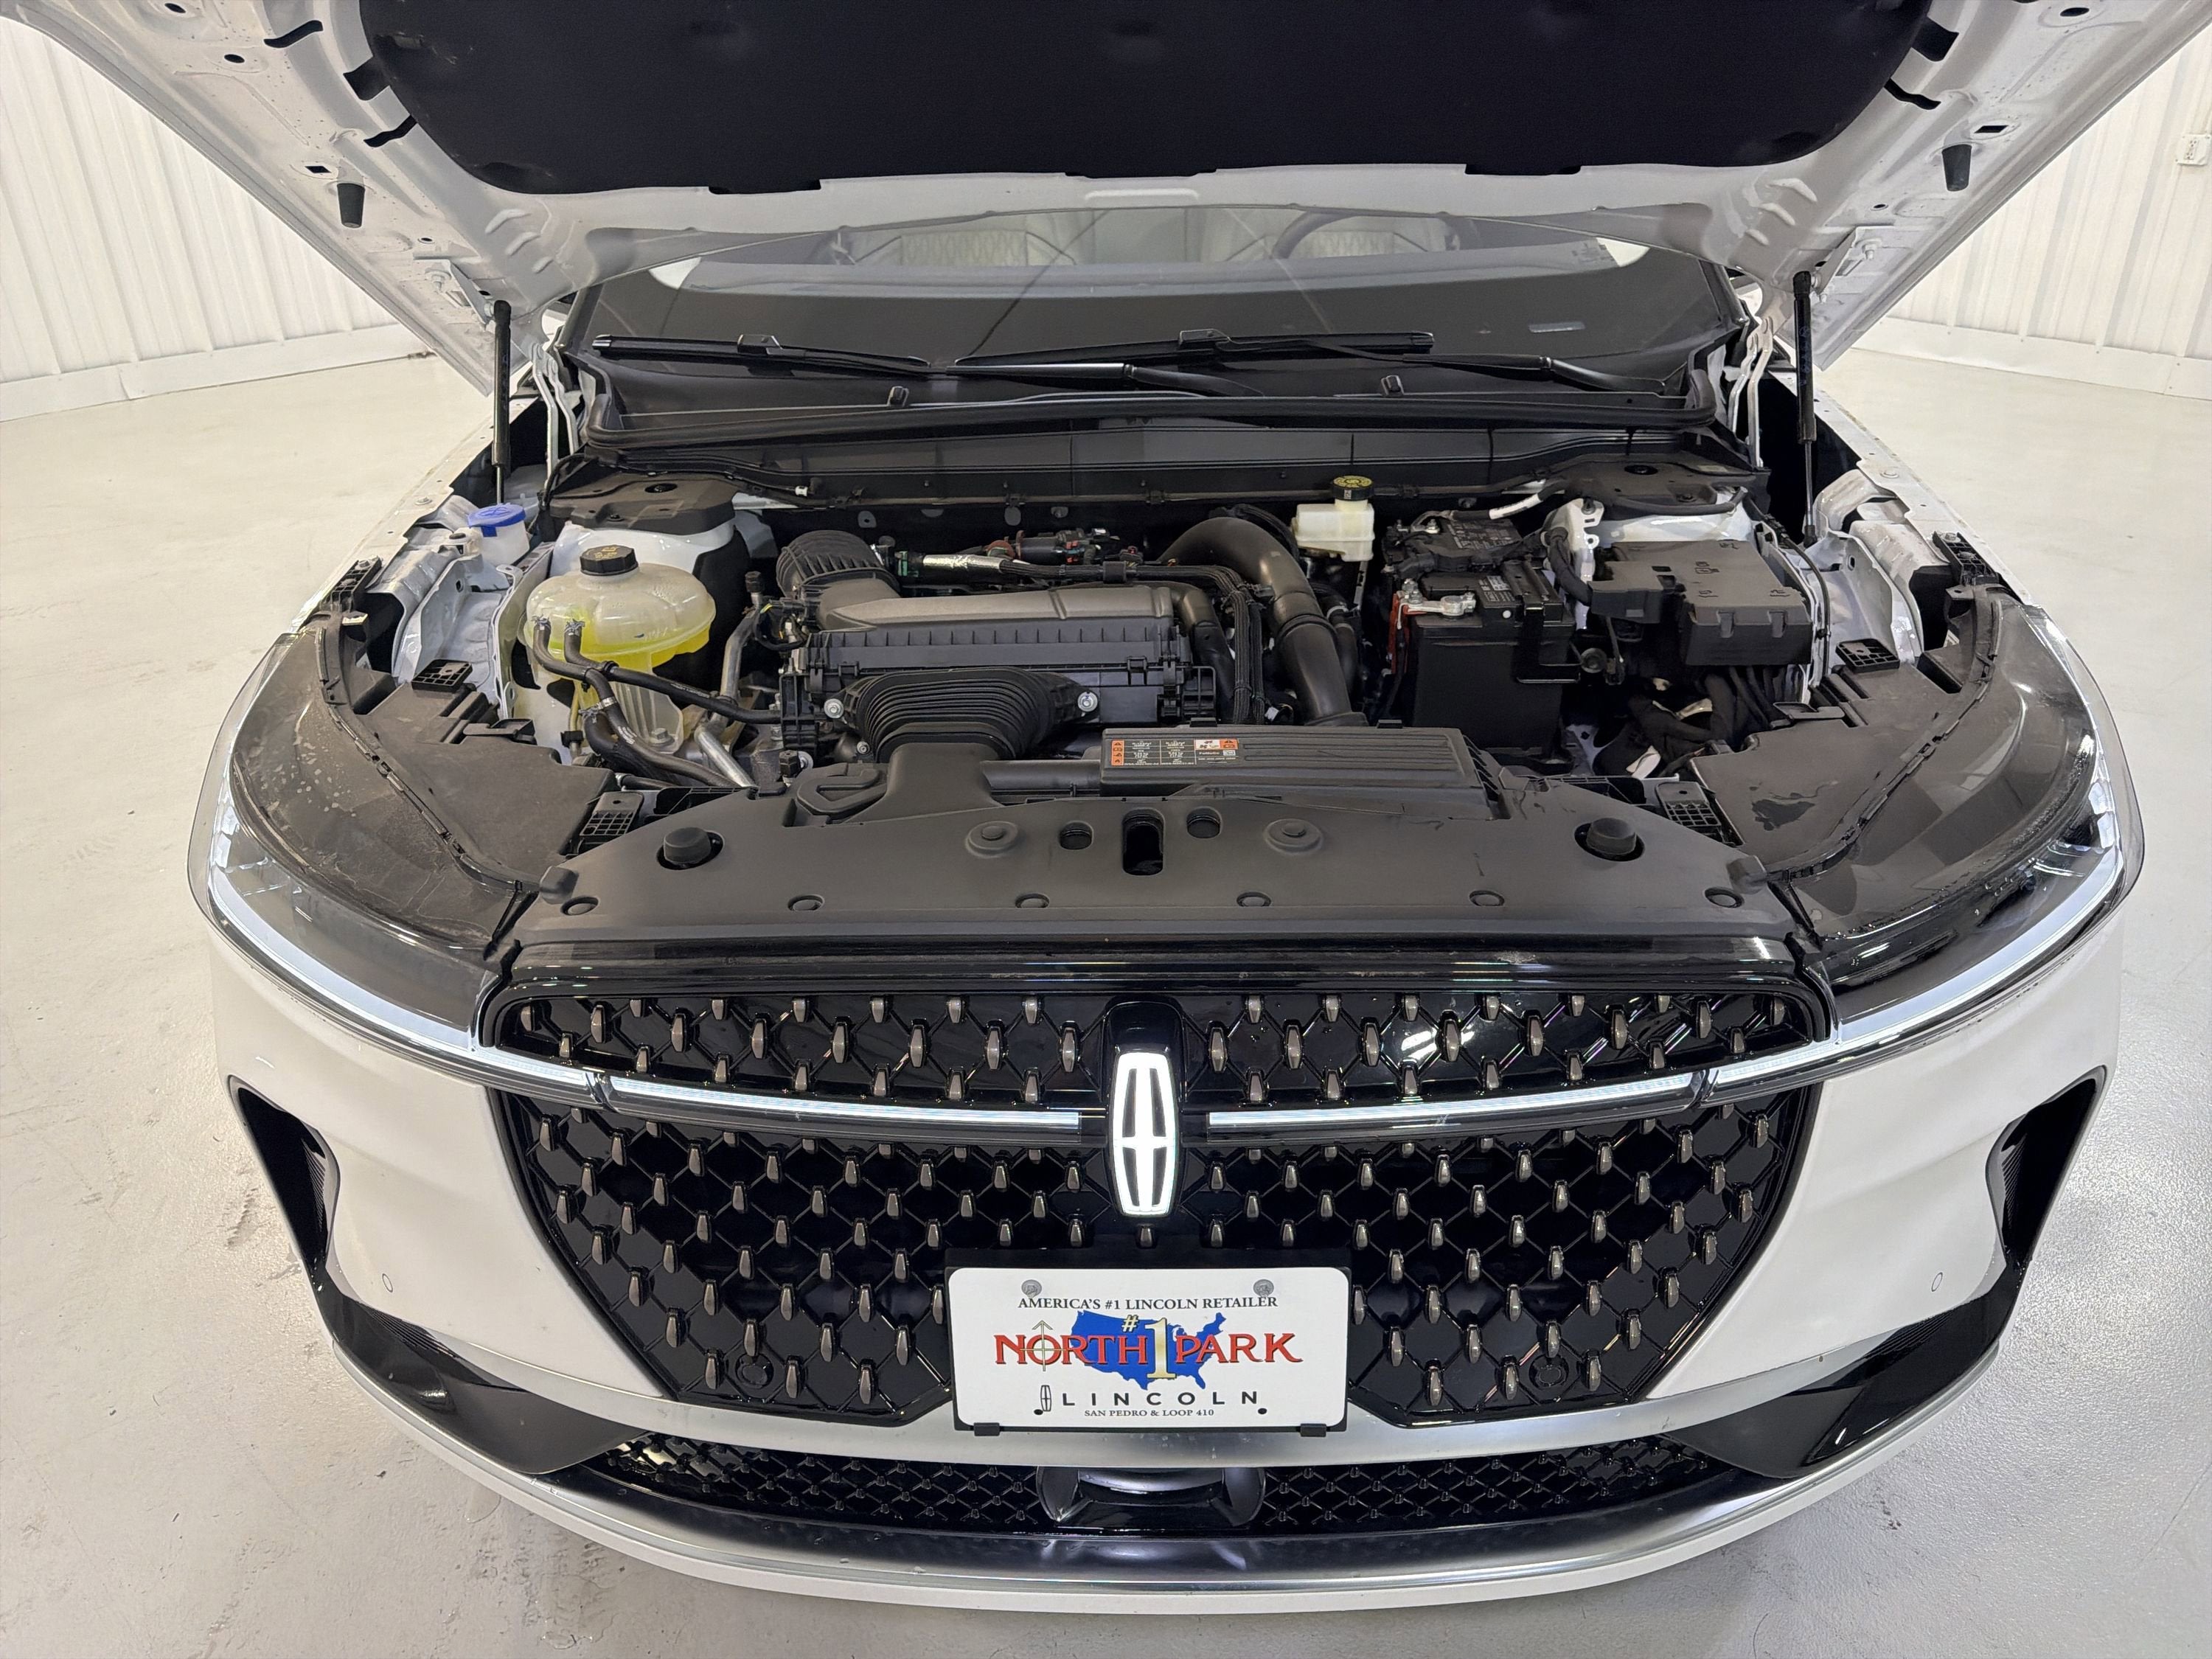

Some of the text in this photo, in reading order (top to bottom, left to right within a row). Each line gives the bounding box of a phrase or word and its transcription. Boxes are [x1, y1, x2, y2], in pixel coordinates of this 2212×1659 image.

[1018, 1296, 1279, 1310] AMERICA'S #1 LINCOLN RETAILER
[993, 1332, 1304, 1366] NORTH PARK
[1062, 1391, 1258, 1406] LINCOLN
[1084, 1409, 1106, 1417] SAN
[1109, 1409, 1147, 1417] PEDRO
